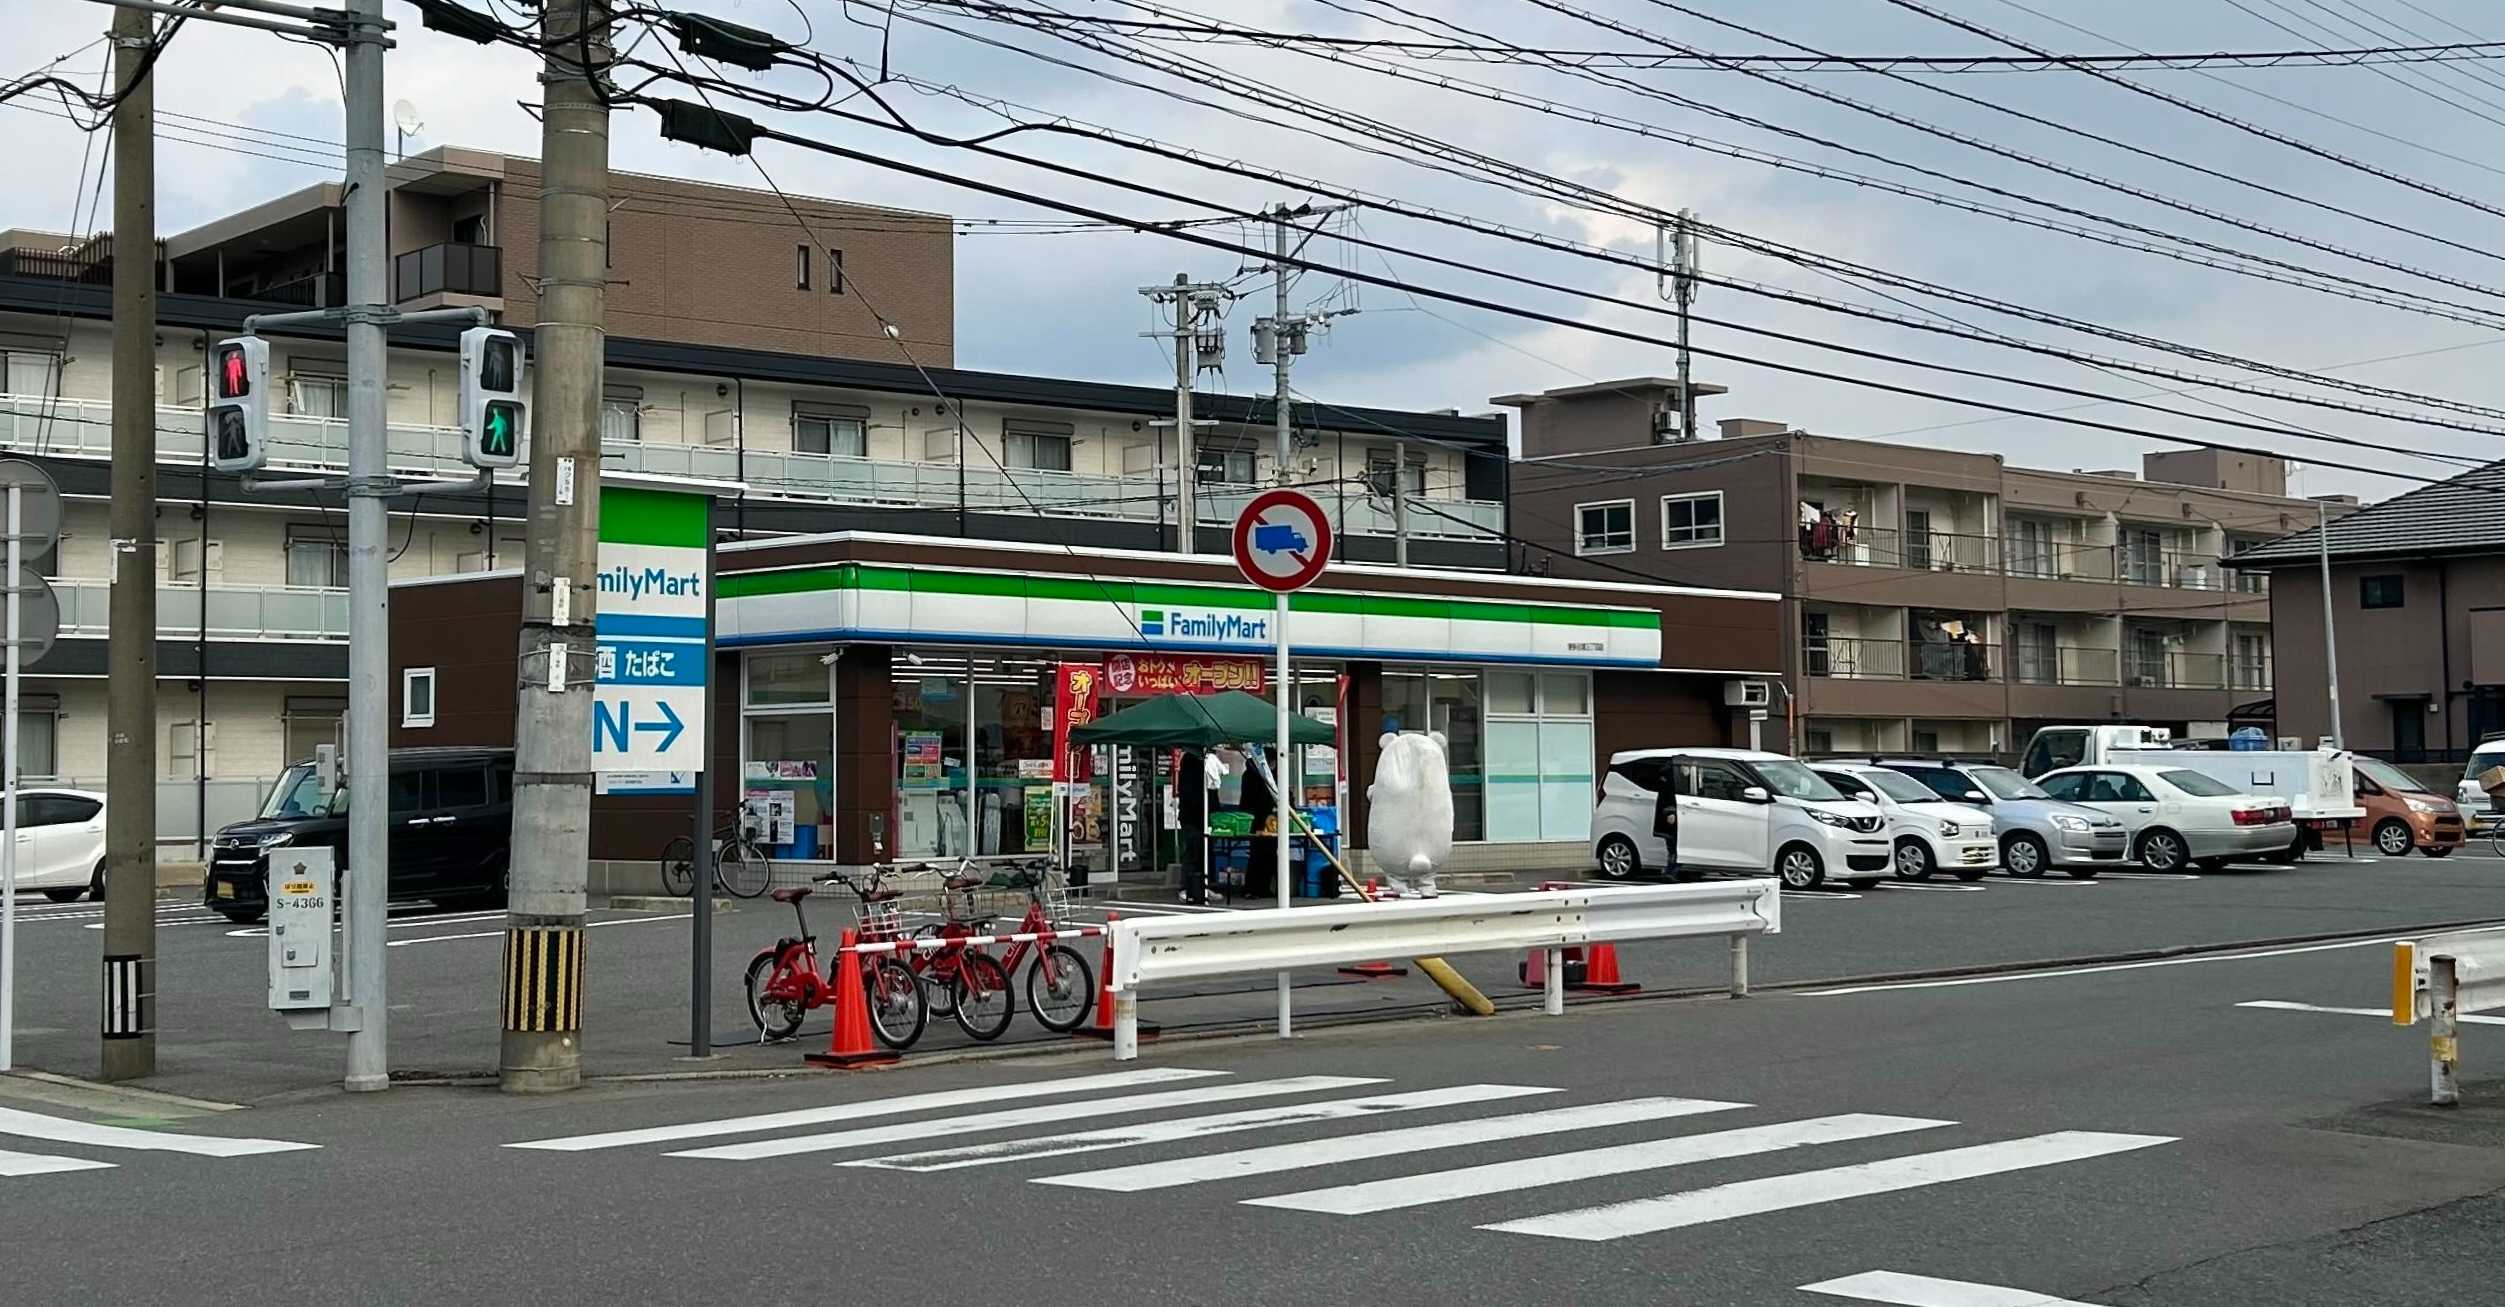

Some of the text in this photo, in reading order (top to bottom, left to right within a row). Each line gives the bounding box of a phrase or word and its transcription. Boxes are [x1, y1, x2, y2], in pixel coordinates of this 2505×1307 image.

[1171, 612, 1266, 641] FamilyMart
[595, 646, 617, 679] 酒
[625, 650, 675, 677] たばこ
[593, 701, 629, 752] N
